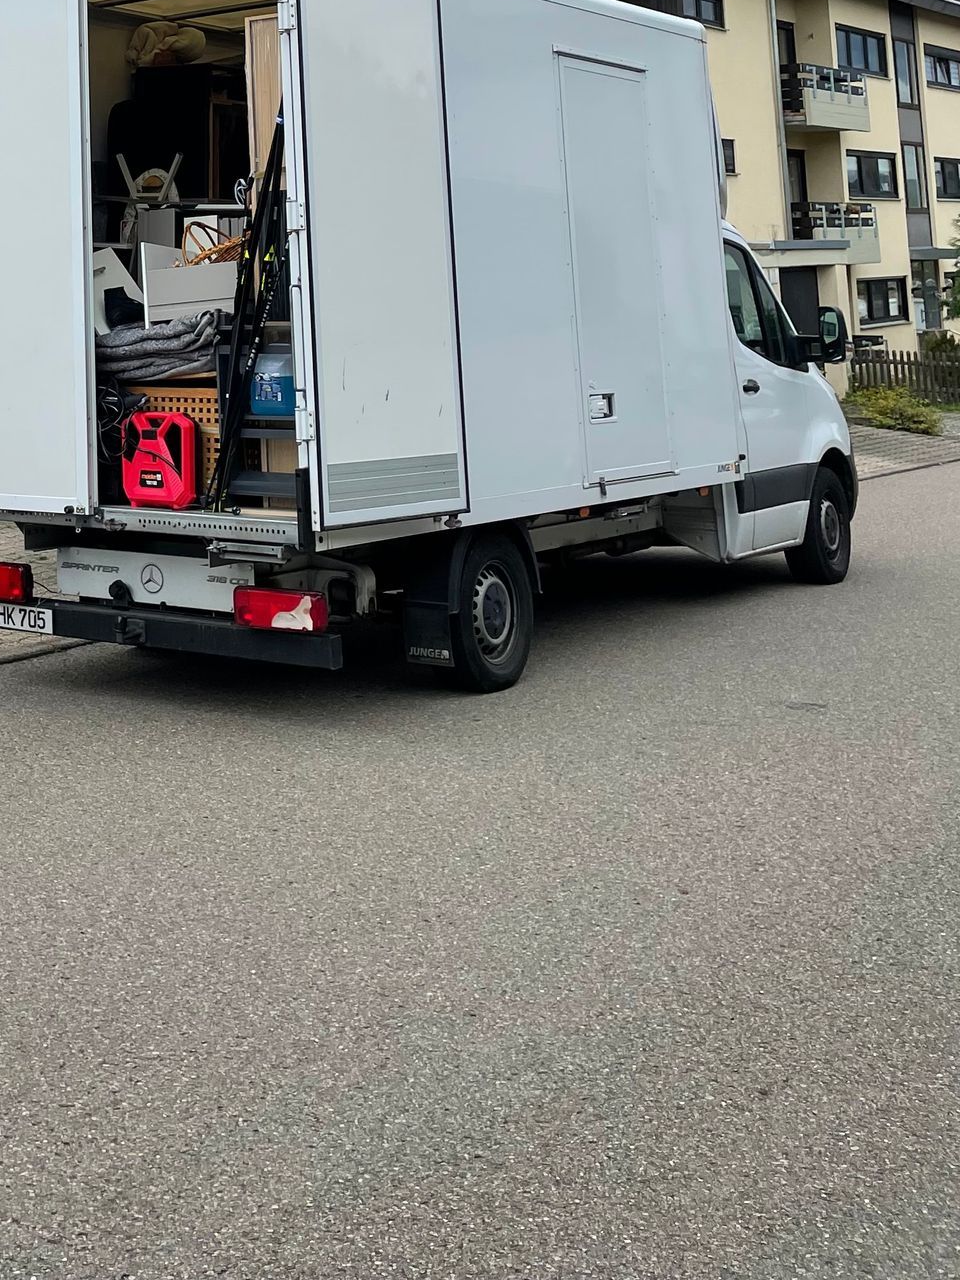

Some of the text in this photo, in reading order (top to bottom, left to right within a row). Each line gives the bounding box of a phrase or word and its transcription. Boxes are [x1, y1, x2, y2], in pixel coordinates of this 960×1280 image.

[61, 561, 120, 574] SPRINTER
[18, 608, 46, 630] 705
[409, 646, 441, 659] JUNGE
